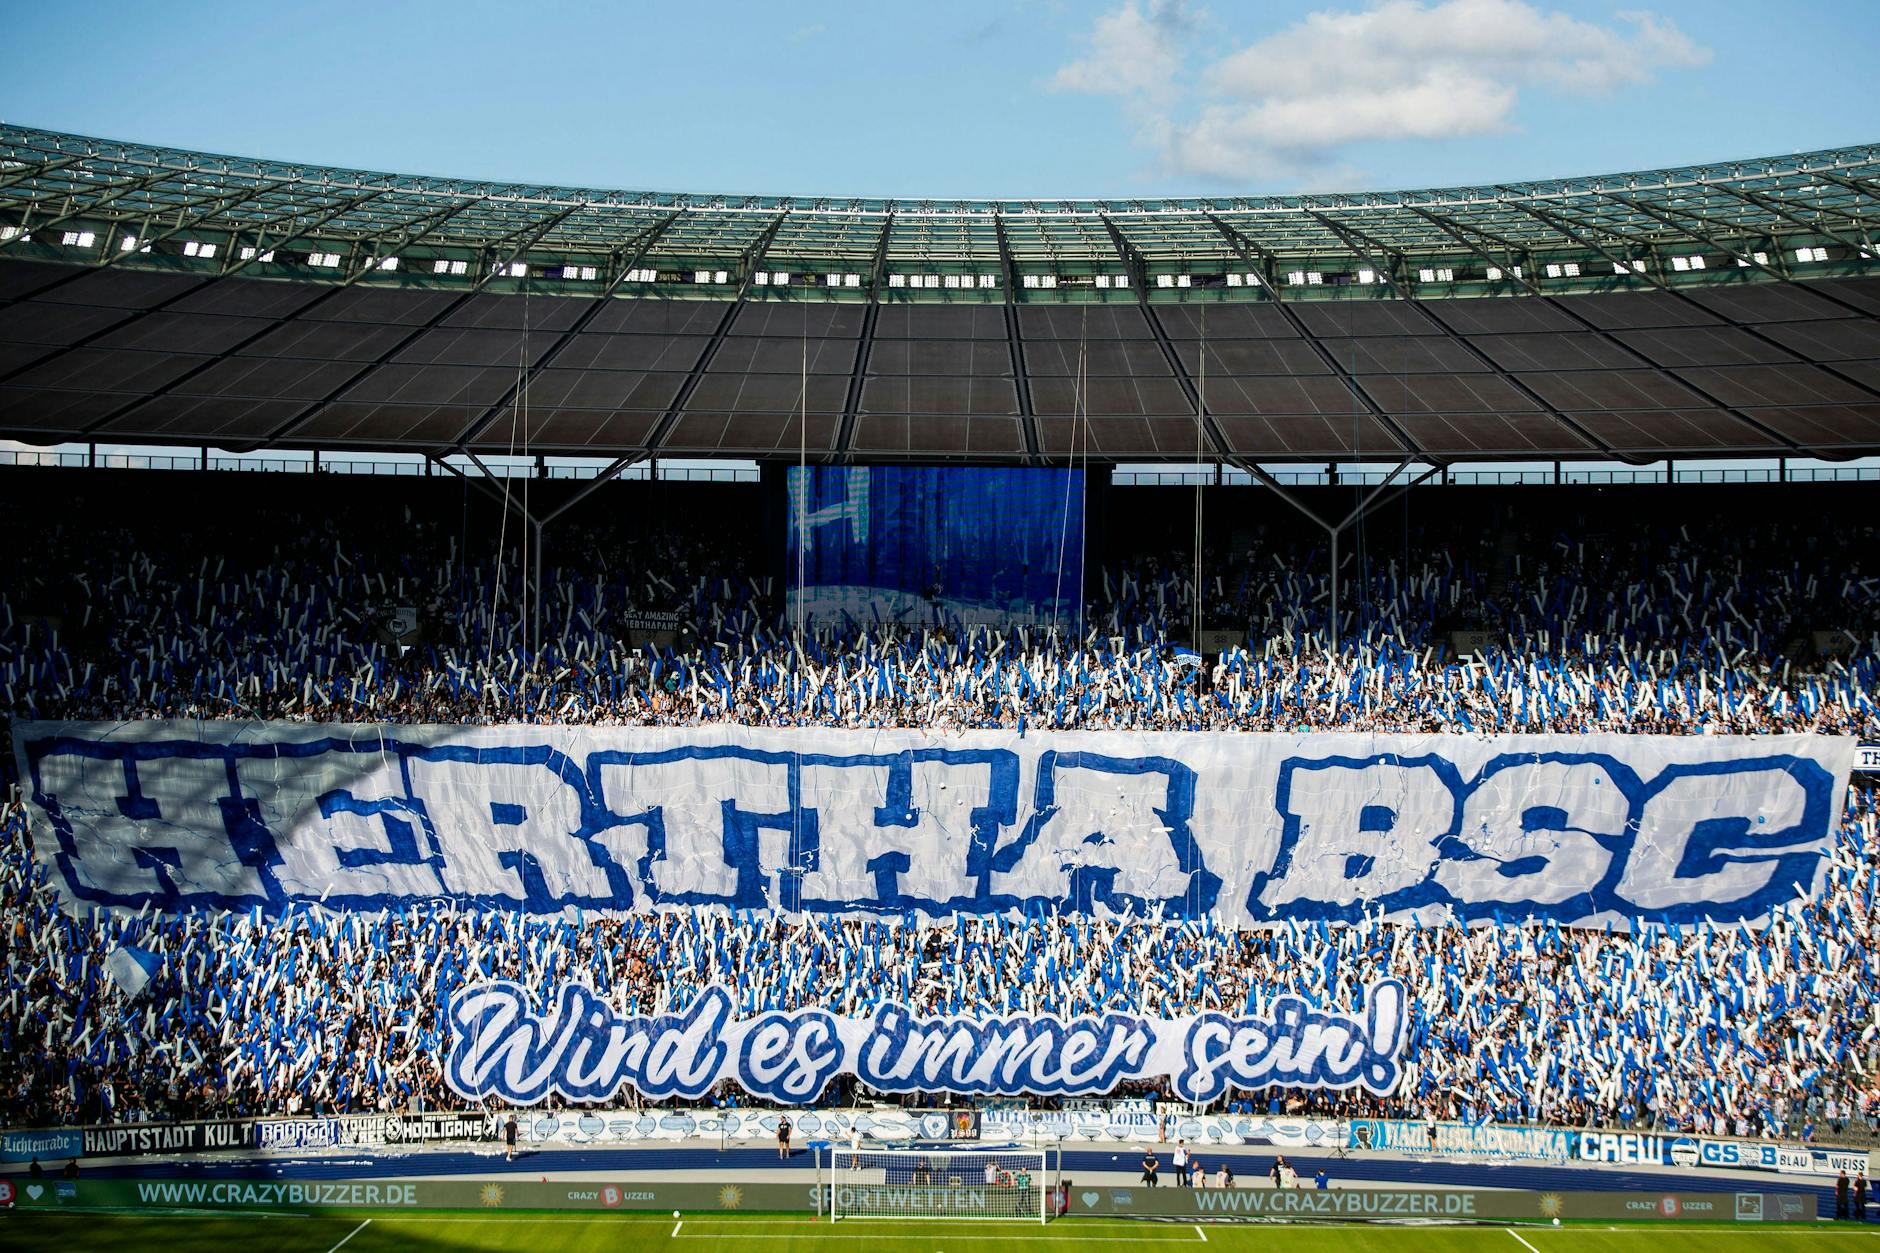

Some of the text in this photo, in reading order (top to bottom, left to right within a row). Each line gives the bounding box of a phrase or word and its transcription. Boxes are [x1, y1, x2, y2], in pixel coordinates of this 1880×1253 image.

[645, 610, 679, 622] AMAZING
[32, 738, 1834, 923] HERTHA BSC
[455, 982, 1401, 1098] Wird es immer sein!
[85, 1125, 196, 1151] HAUPTSTADT
[403, 1119, 482, 1139] HOOLIGANS
[4, 1134, 70, 1155] Lichtenrade
[1580, 1132, 1663, 1164] CREW
[1703, 1142, 1739, 1163] GS
[1779, 1153, 1865, 1171] BLAU WEISS
[138, 1182, 417, 1204] WWW.CRAZYBUZZER.DE
[567, 1191, 599, 1200] CRAZY
[808, 1187, 986, 1209] SPORTWETTEN
[1195, 1191, 1476, 1214] WWW.CRAZYBUZZER.DE
[1625, 1201, 1657, 1210] CRAZY
